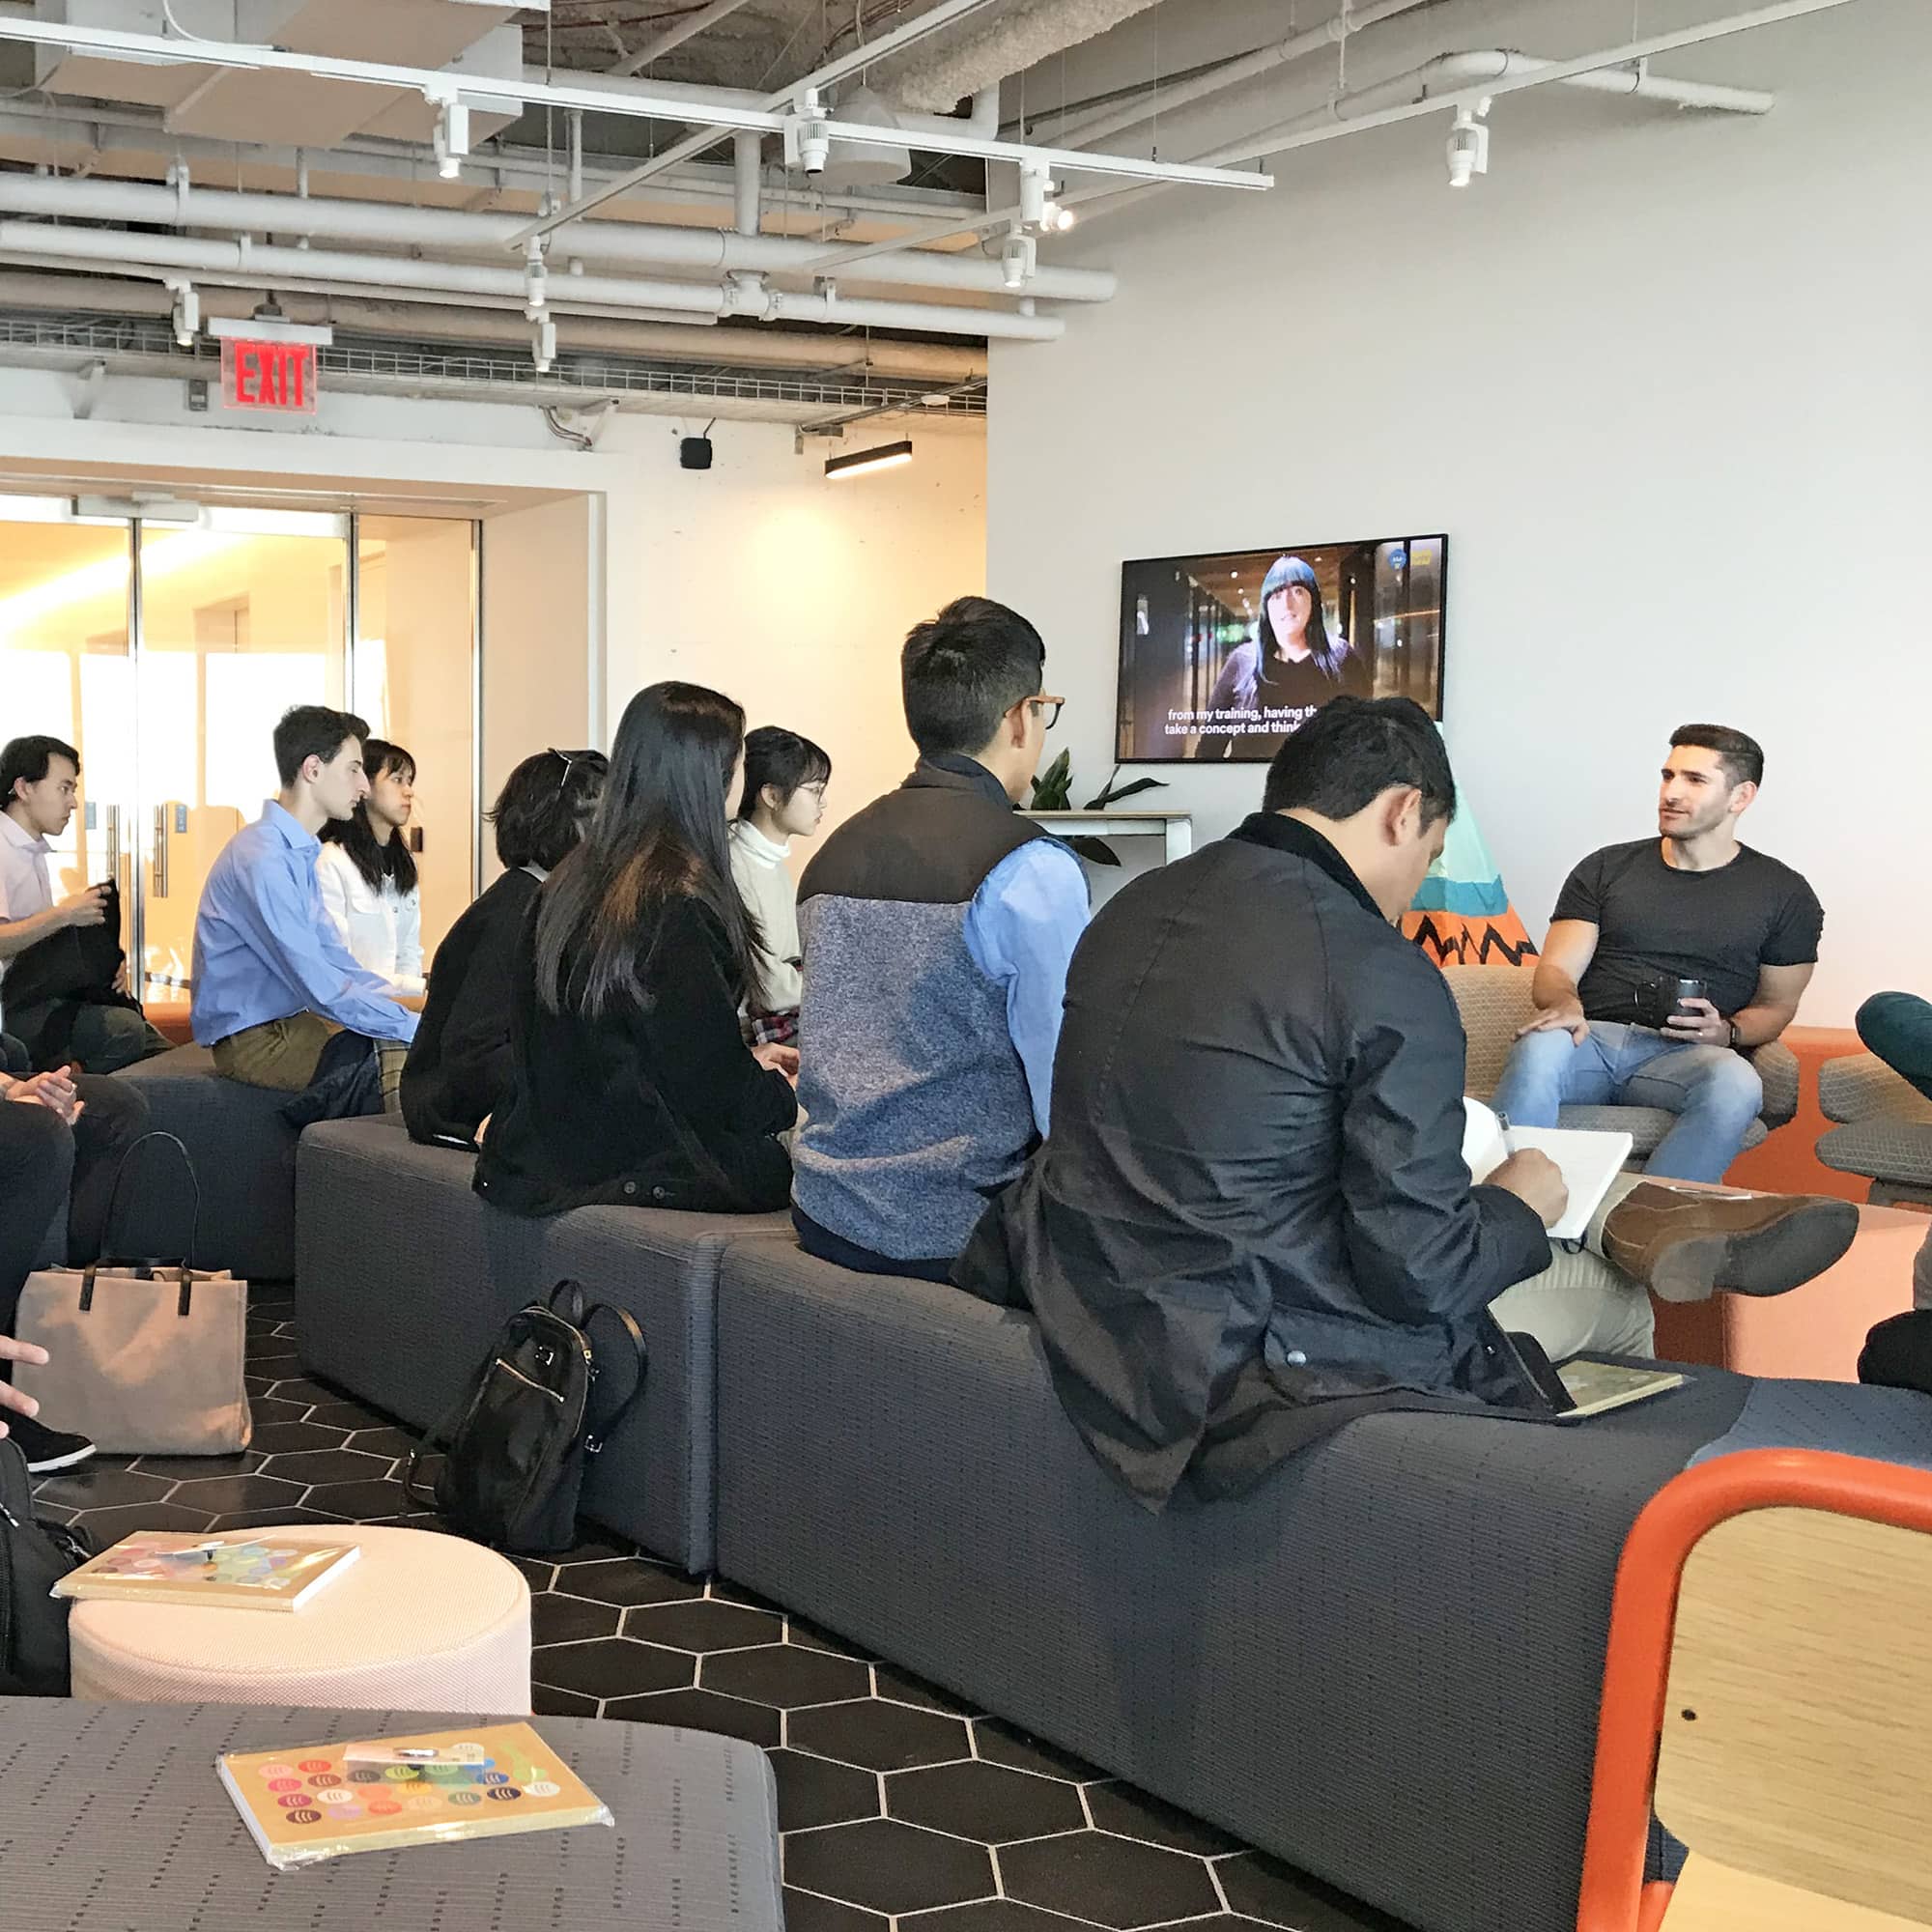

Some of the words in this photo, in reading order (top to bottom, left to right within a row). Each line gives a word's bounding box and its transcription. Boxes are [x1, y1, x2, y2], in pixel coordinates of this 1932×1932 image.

[235, 342, 309, 407] EXIT
[1168, 709, 1195, 721] from
[1196, 710, 1214, 723] my
[1215, 706, 1262, 722] training,
[1264, 705, 1303, 721] having
[1164, 723, 1188, 735] take
[1189, 724, 1197, 735] a
[1199, 723, 1246, 737] concept
[1247, 721, 1269, 734] and
